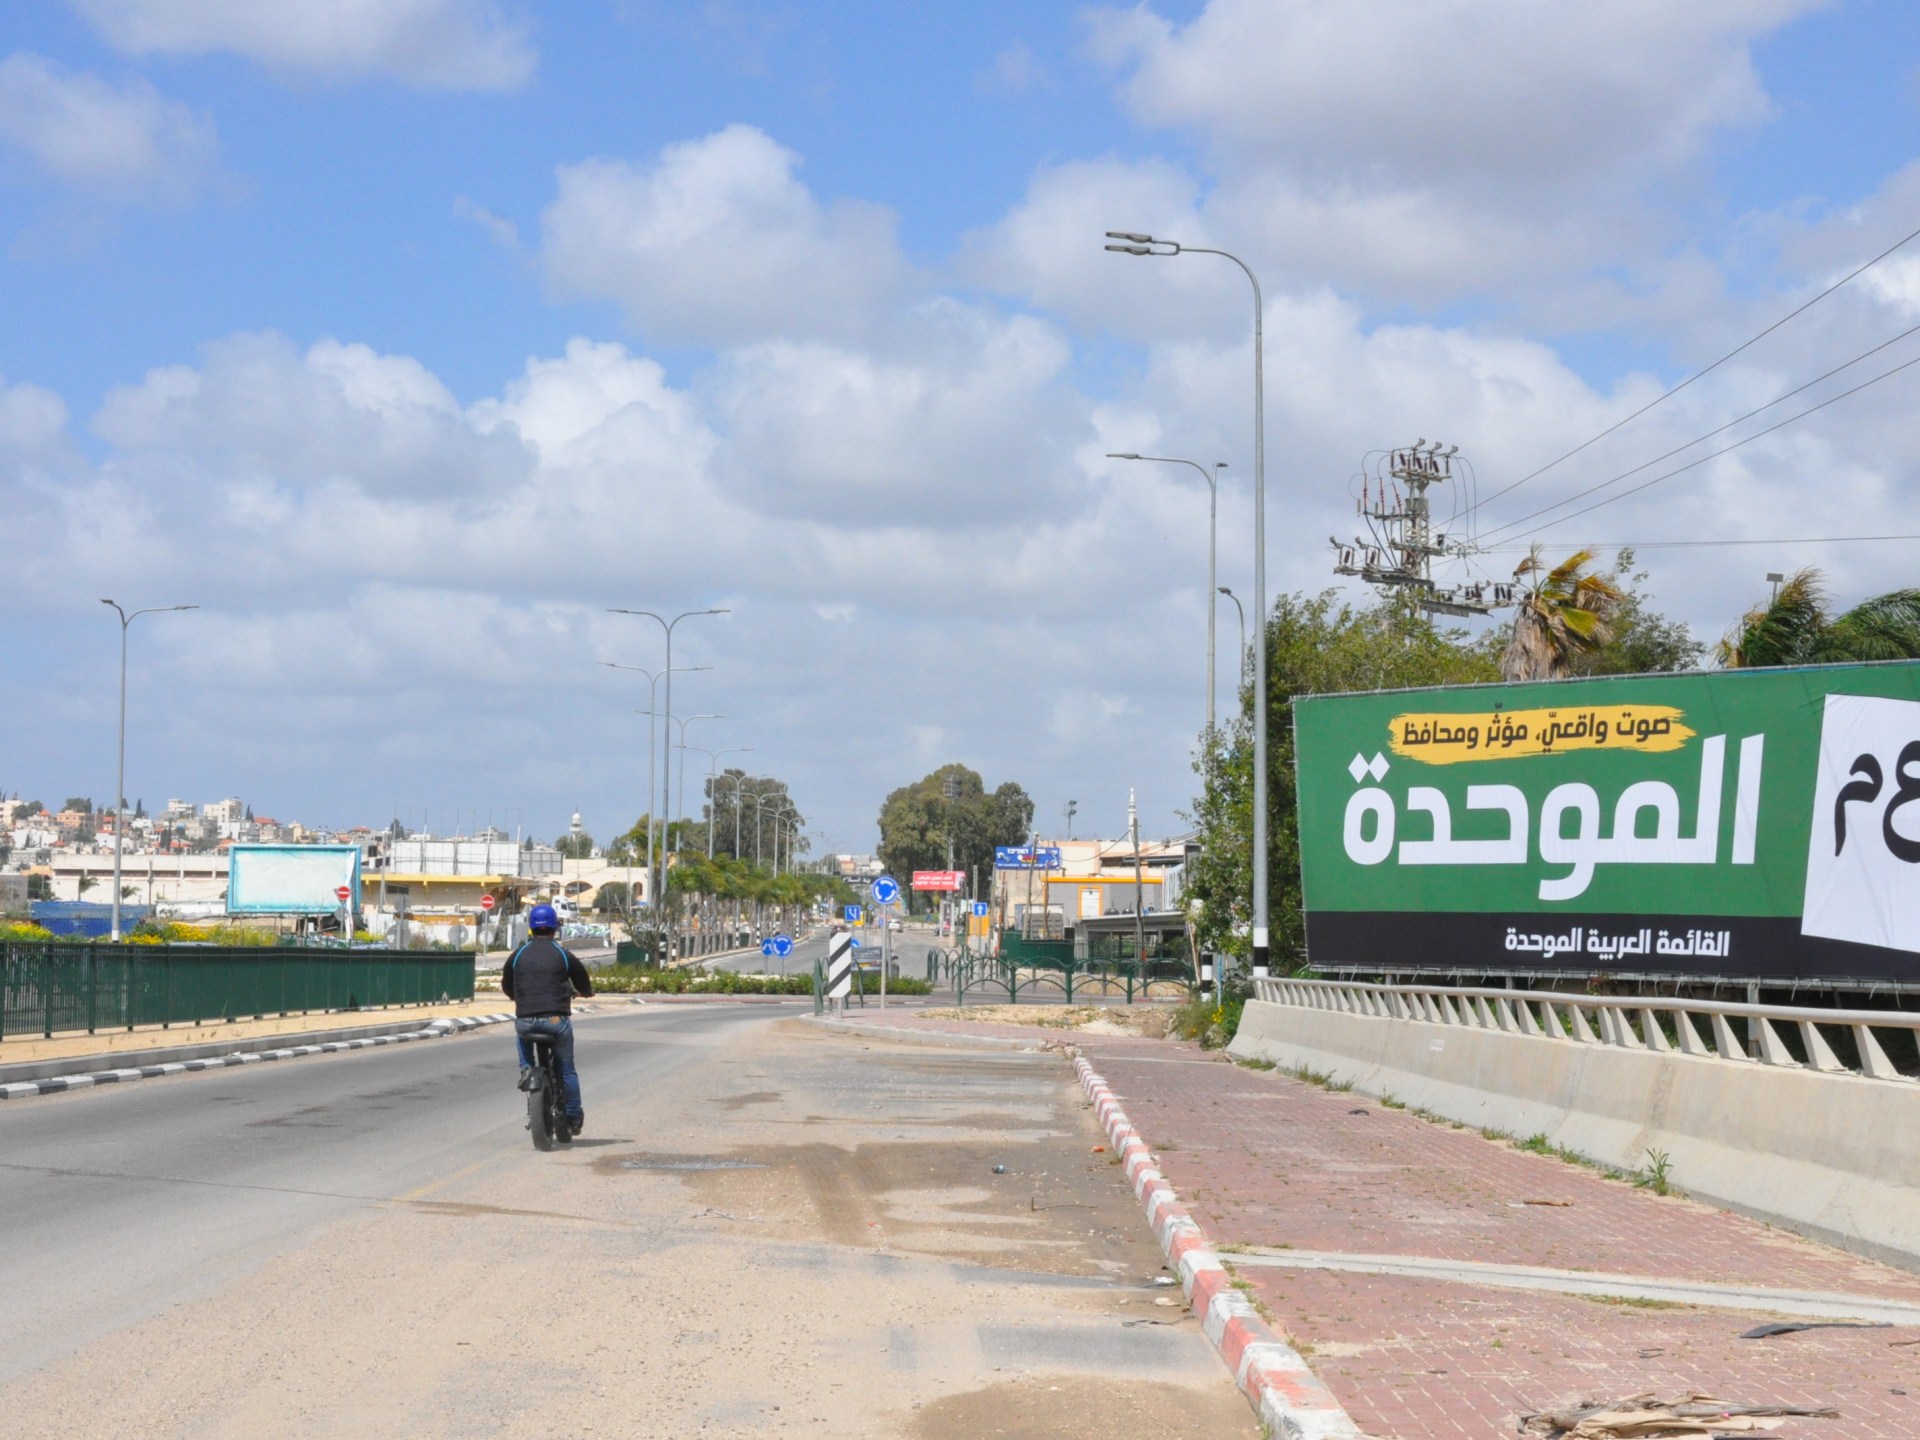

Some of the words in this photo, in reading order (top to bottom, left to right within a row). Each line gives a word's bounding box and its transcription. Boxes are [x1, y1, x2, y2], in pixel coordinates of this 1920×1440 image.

[1402, 719, 1479, 749] ومحافظ
[1616, 711, 1671, 743] صوت
[1342, 732, 1764, 901] الموحدة
[1505, 926, 1582, 958] الموحدة
[1586, 928, 1652, 960] العربية
[1655, 929, 1731, 957] القائمة
